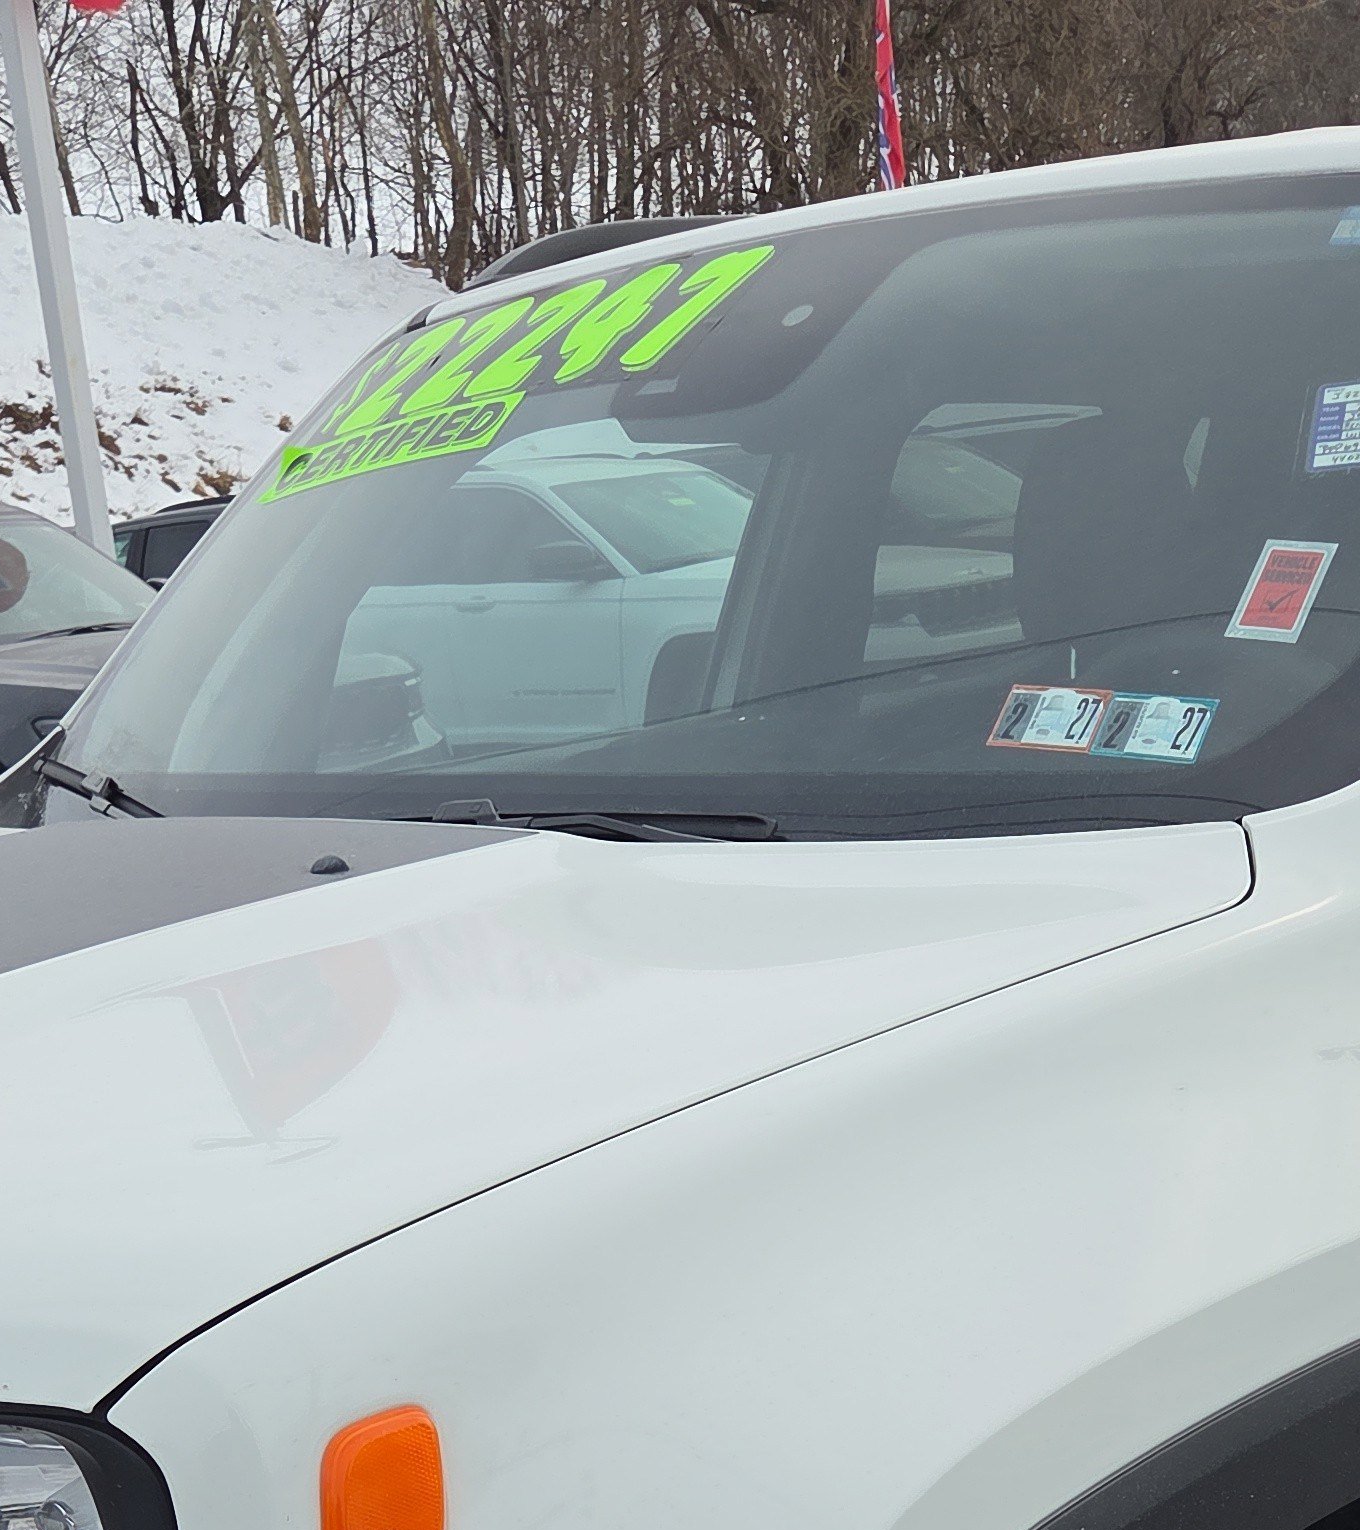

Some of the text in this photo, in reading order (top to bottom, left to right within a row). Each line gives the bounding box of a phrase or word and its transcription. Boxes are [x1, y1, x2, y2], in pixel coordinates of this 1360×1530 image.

[274, 401, 506, 493] CERTIFIED
[1000, 702, 1029, 740] 2
[1064, 697, 1104, 742] 27
[1101, 709, 1131, 750] 2
[1170, 706, 1209, 751] 27
